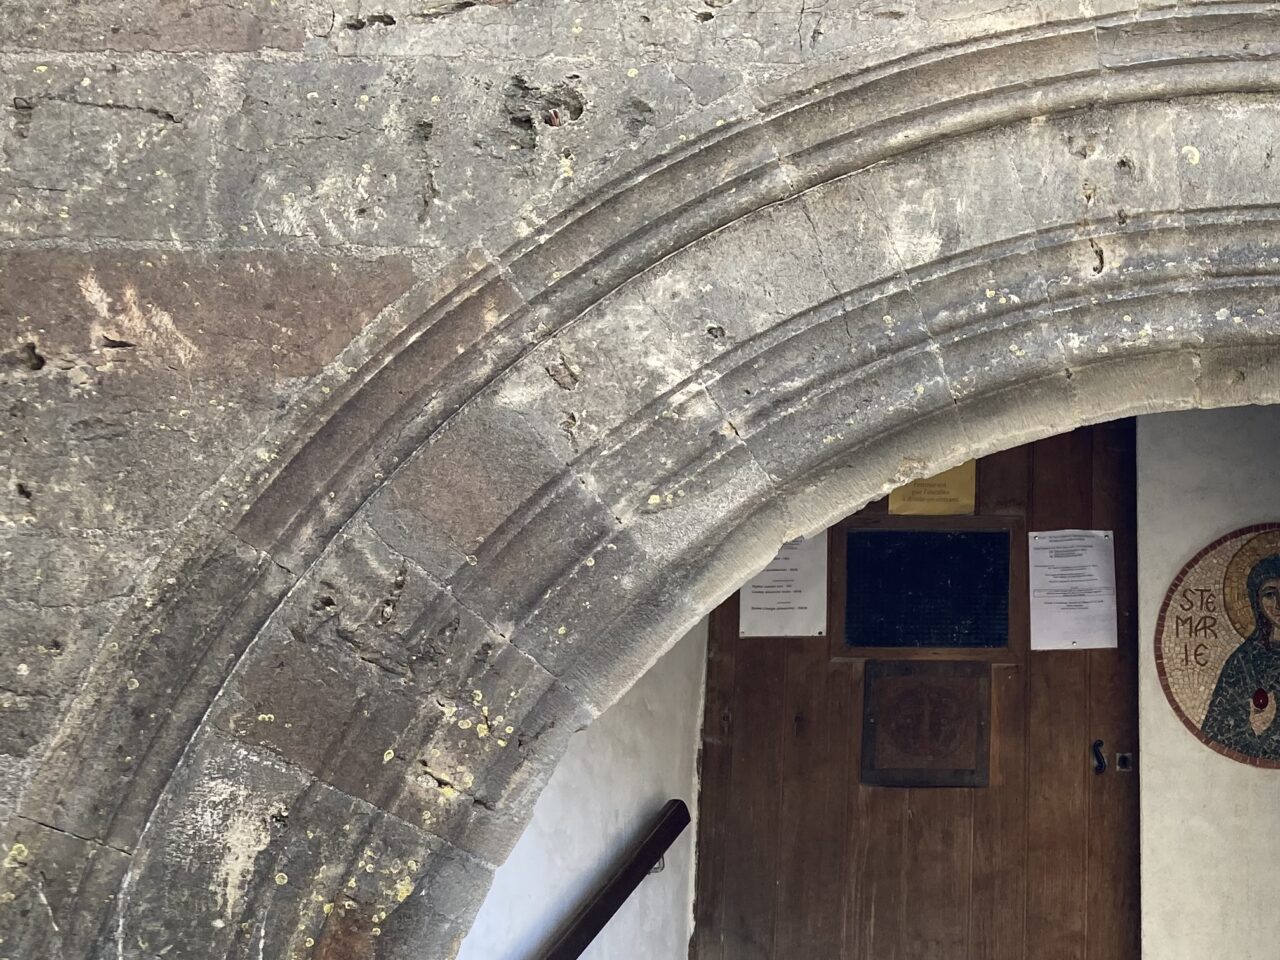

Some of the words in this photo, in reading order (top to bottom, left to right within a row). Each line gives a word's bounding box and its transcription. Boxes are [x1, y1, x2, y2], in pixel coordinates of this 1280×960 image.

[1179, 588, 1217, 612] STE
[1175, 616, 1218, 639] MAR
[1183, 643, 1209, 667] IE
